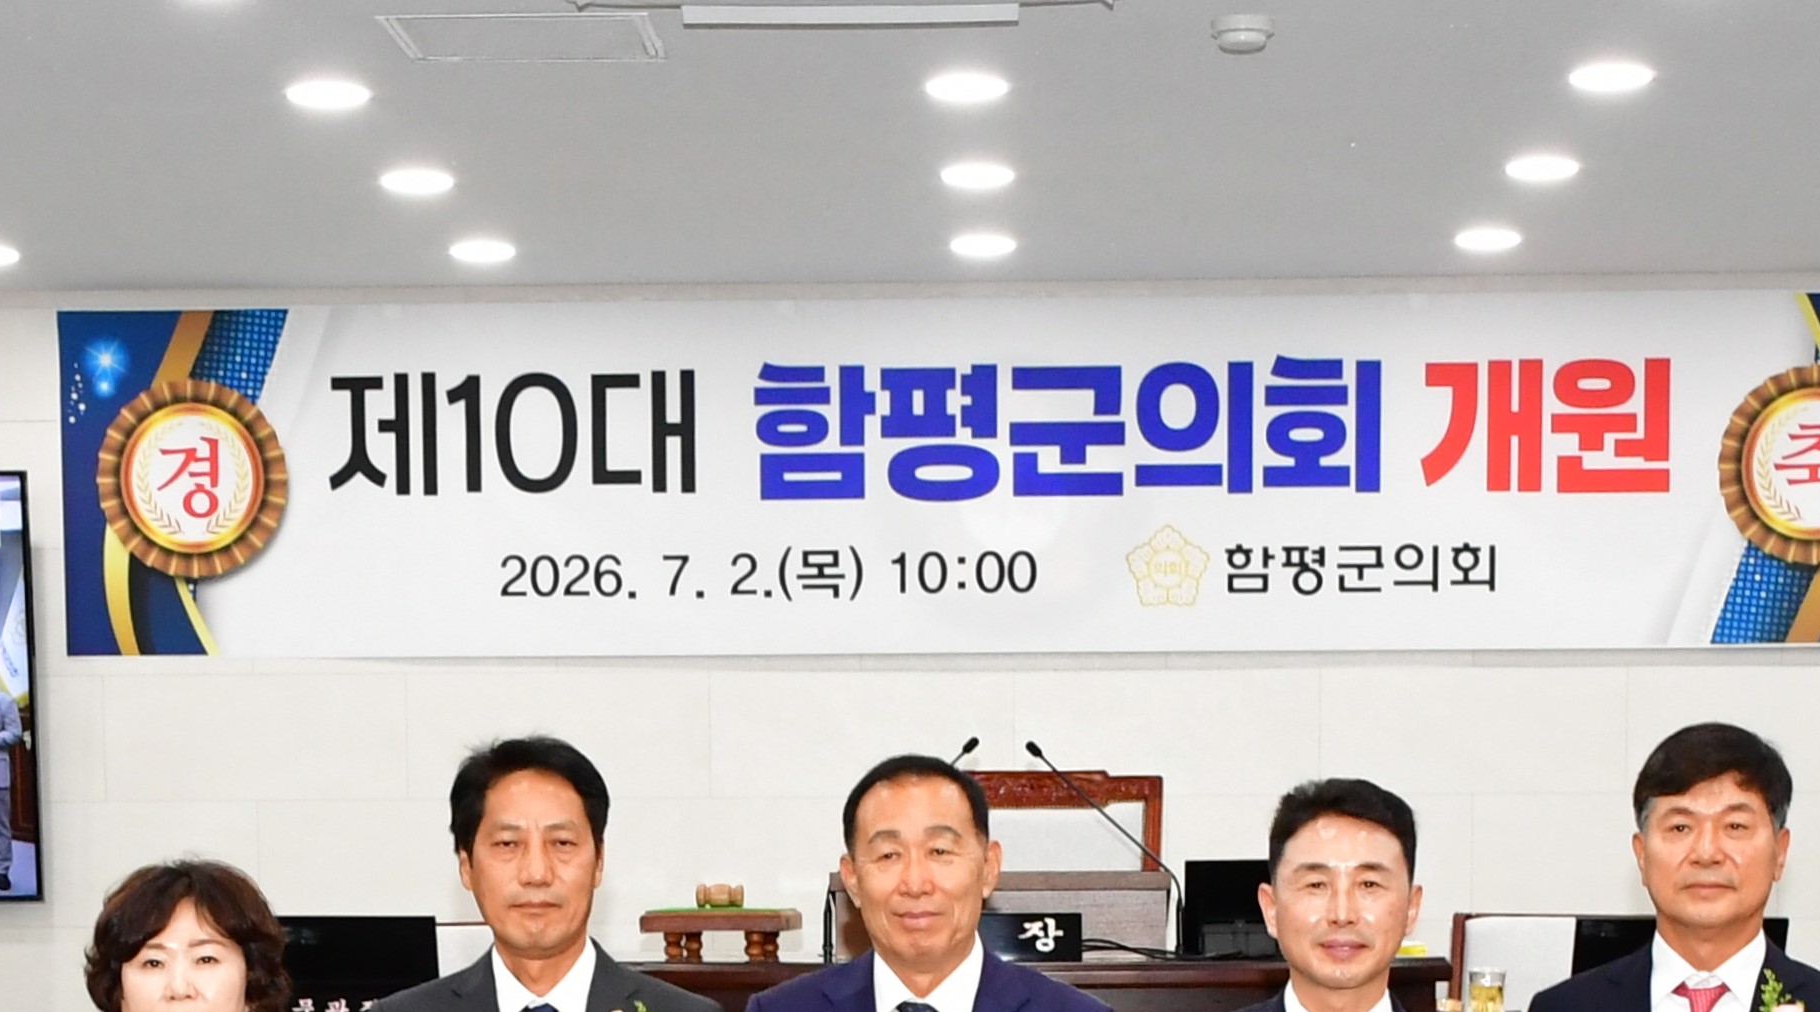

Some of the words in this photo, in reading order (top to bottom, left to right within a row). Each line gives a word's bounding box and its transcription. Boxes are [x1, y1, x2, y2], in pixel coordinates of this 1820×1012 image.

[328, 368, 697, 497] 제10대
[753, 354, 1382, 503] 함평군의회
[1420, 357, 1672, 494] 개원
[157, 436, 219, 518] 경
[500, 554, 637, 599] 2026.
[662, 555, 705, 599] 7.
[891, 550, 1037, 594] 10:00
[1225, 542, 1496, 596] 함평군의회
[1017, 917, 1064, 952] 장
